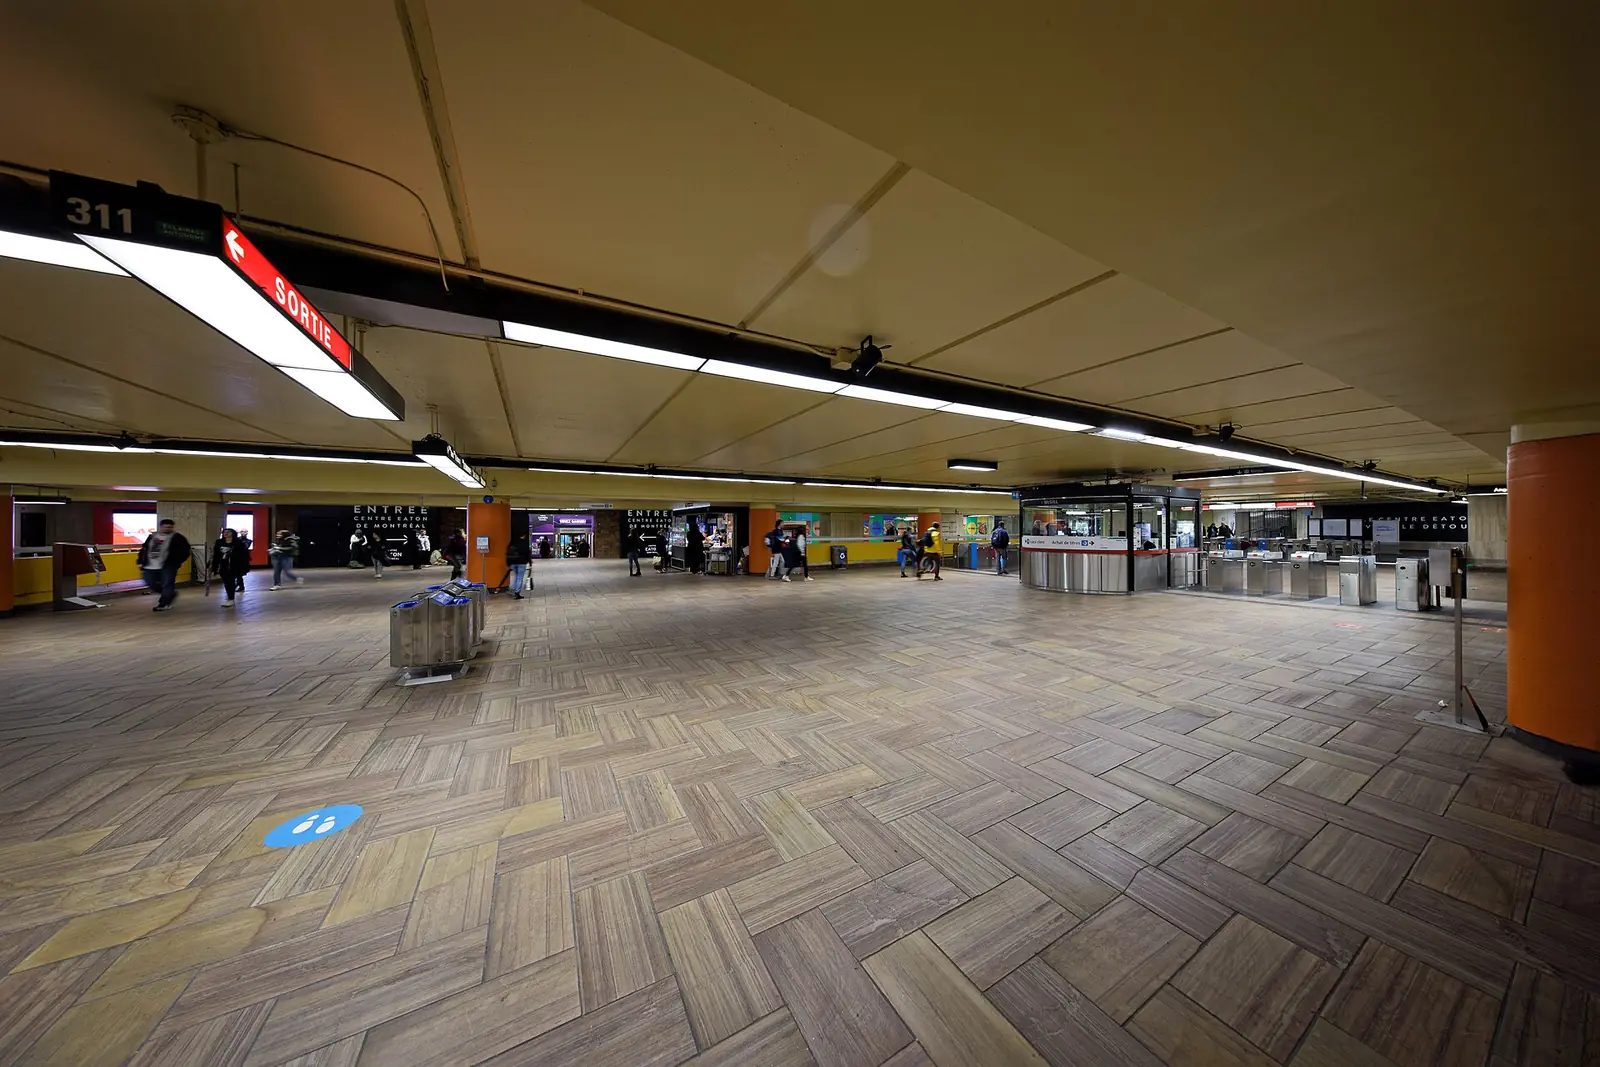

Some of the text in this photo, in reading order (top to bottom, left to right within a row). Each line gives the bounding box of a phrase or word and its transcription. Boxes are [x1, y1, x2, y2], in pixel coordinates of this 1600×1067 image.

[67, 197, 132, 234] 311
[275, 276, 332, 350] SORTIE
[627, 509, 669, 518] ENTRE
